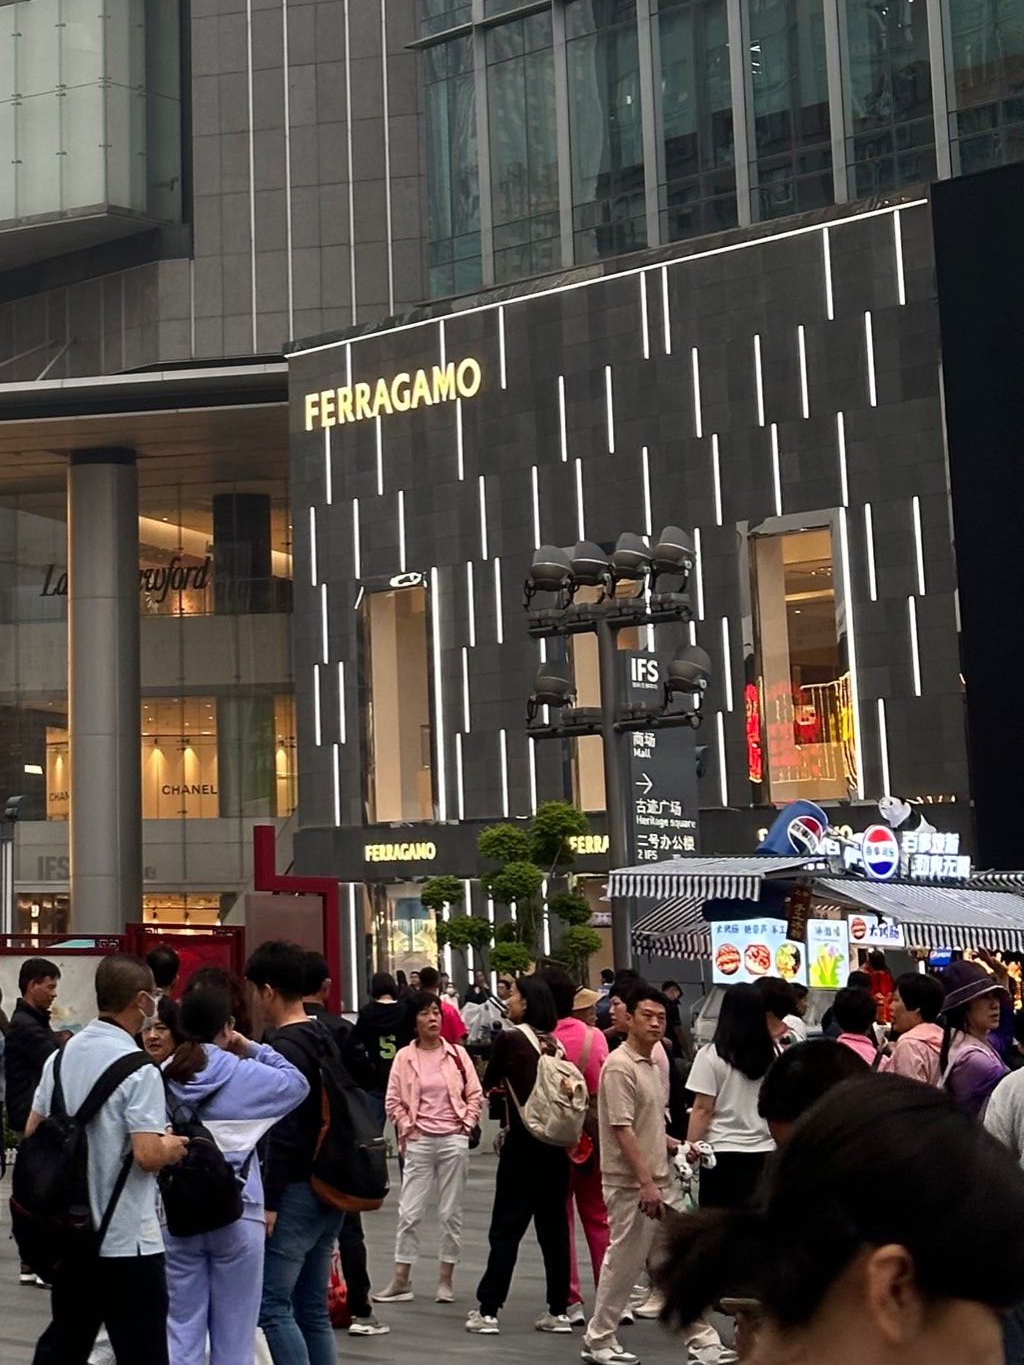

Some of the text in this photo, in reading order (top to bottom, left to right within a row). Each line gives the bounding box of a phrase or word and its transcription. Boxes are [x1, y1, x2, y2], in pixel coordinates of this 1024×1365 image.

[304, 357, 482, 432] FERRAGAMO
[630, 657, 659, 683] IFS
[632, 731, 656, 747] 商场
[633, 748, 651, 758] Mall
[162, 785, 218, 795] CHANEL
[635, 798, 682, 816] 古迹广场
[636, 815, 696, 829] Heritage square
[637, 833, 695, 851] 二号办公楼
[365, 841, 437, 862] FERRAGAMO
[637, 849, 658, 860] 2 IFS
